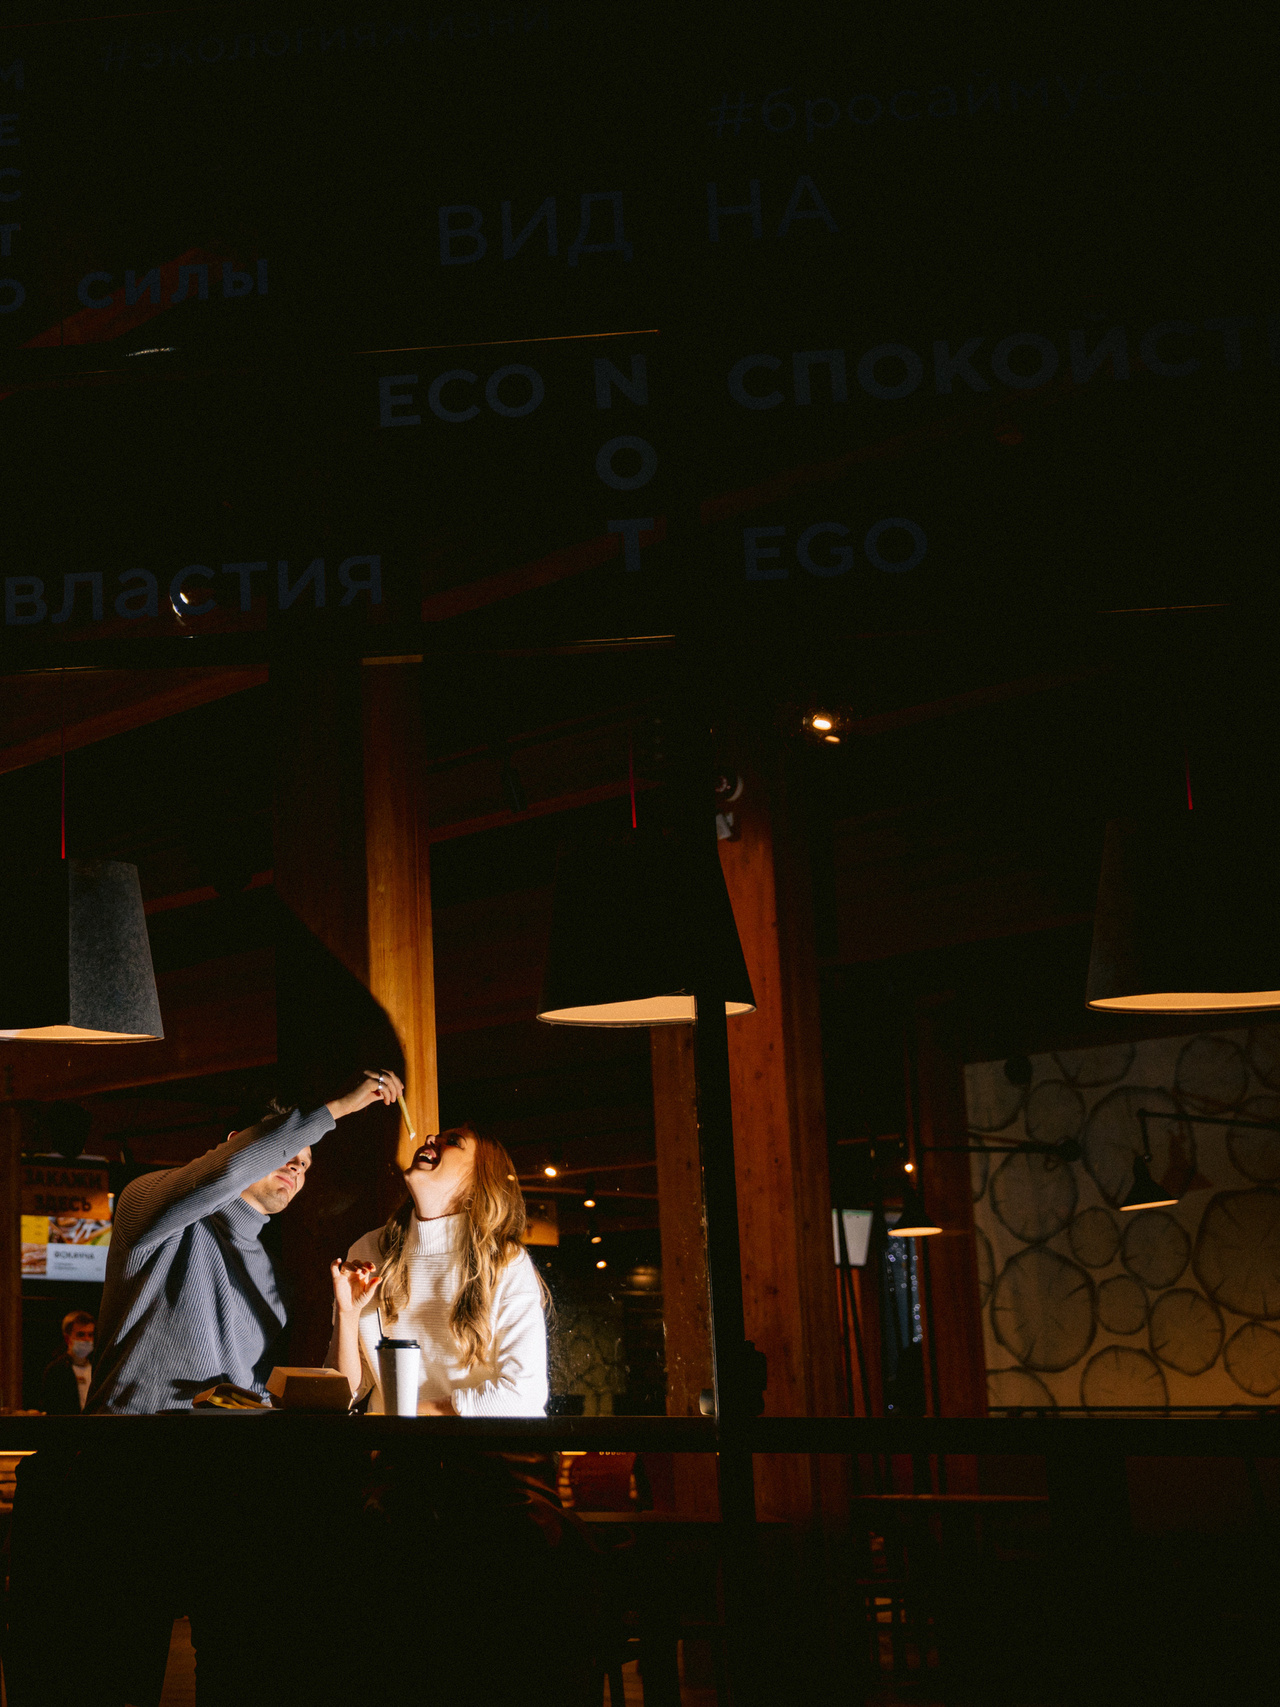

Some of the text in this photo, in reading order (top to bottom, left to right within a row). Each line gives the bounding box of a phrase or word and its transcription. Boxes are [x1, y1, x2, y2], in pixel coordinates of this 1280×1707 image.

[436, 173, 841, 269] ВИД НА
[741, 516, 930, 583] EGO
